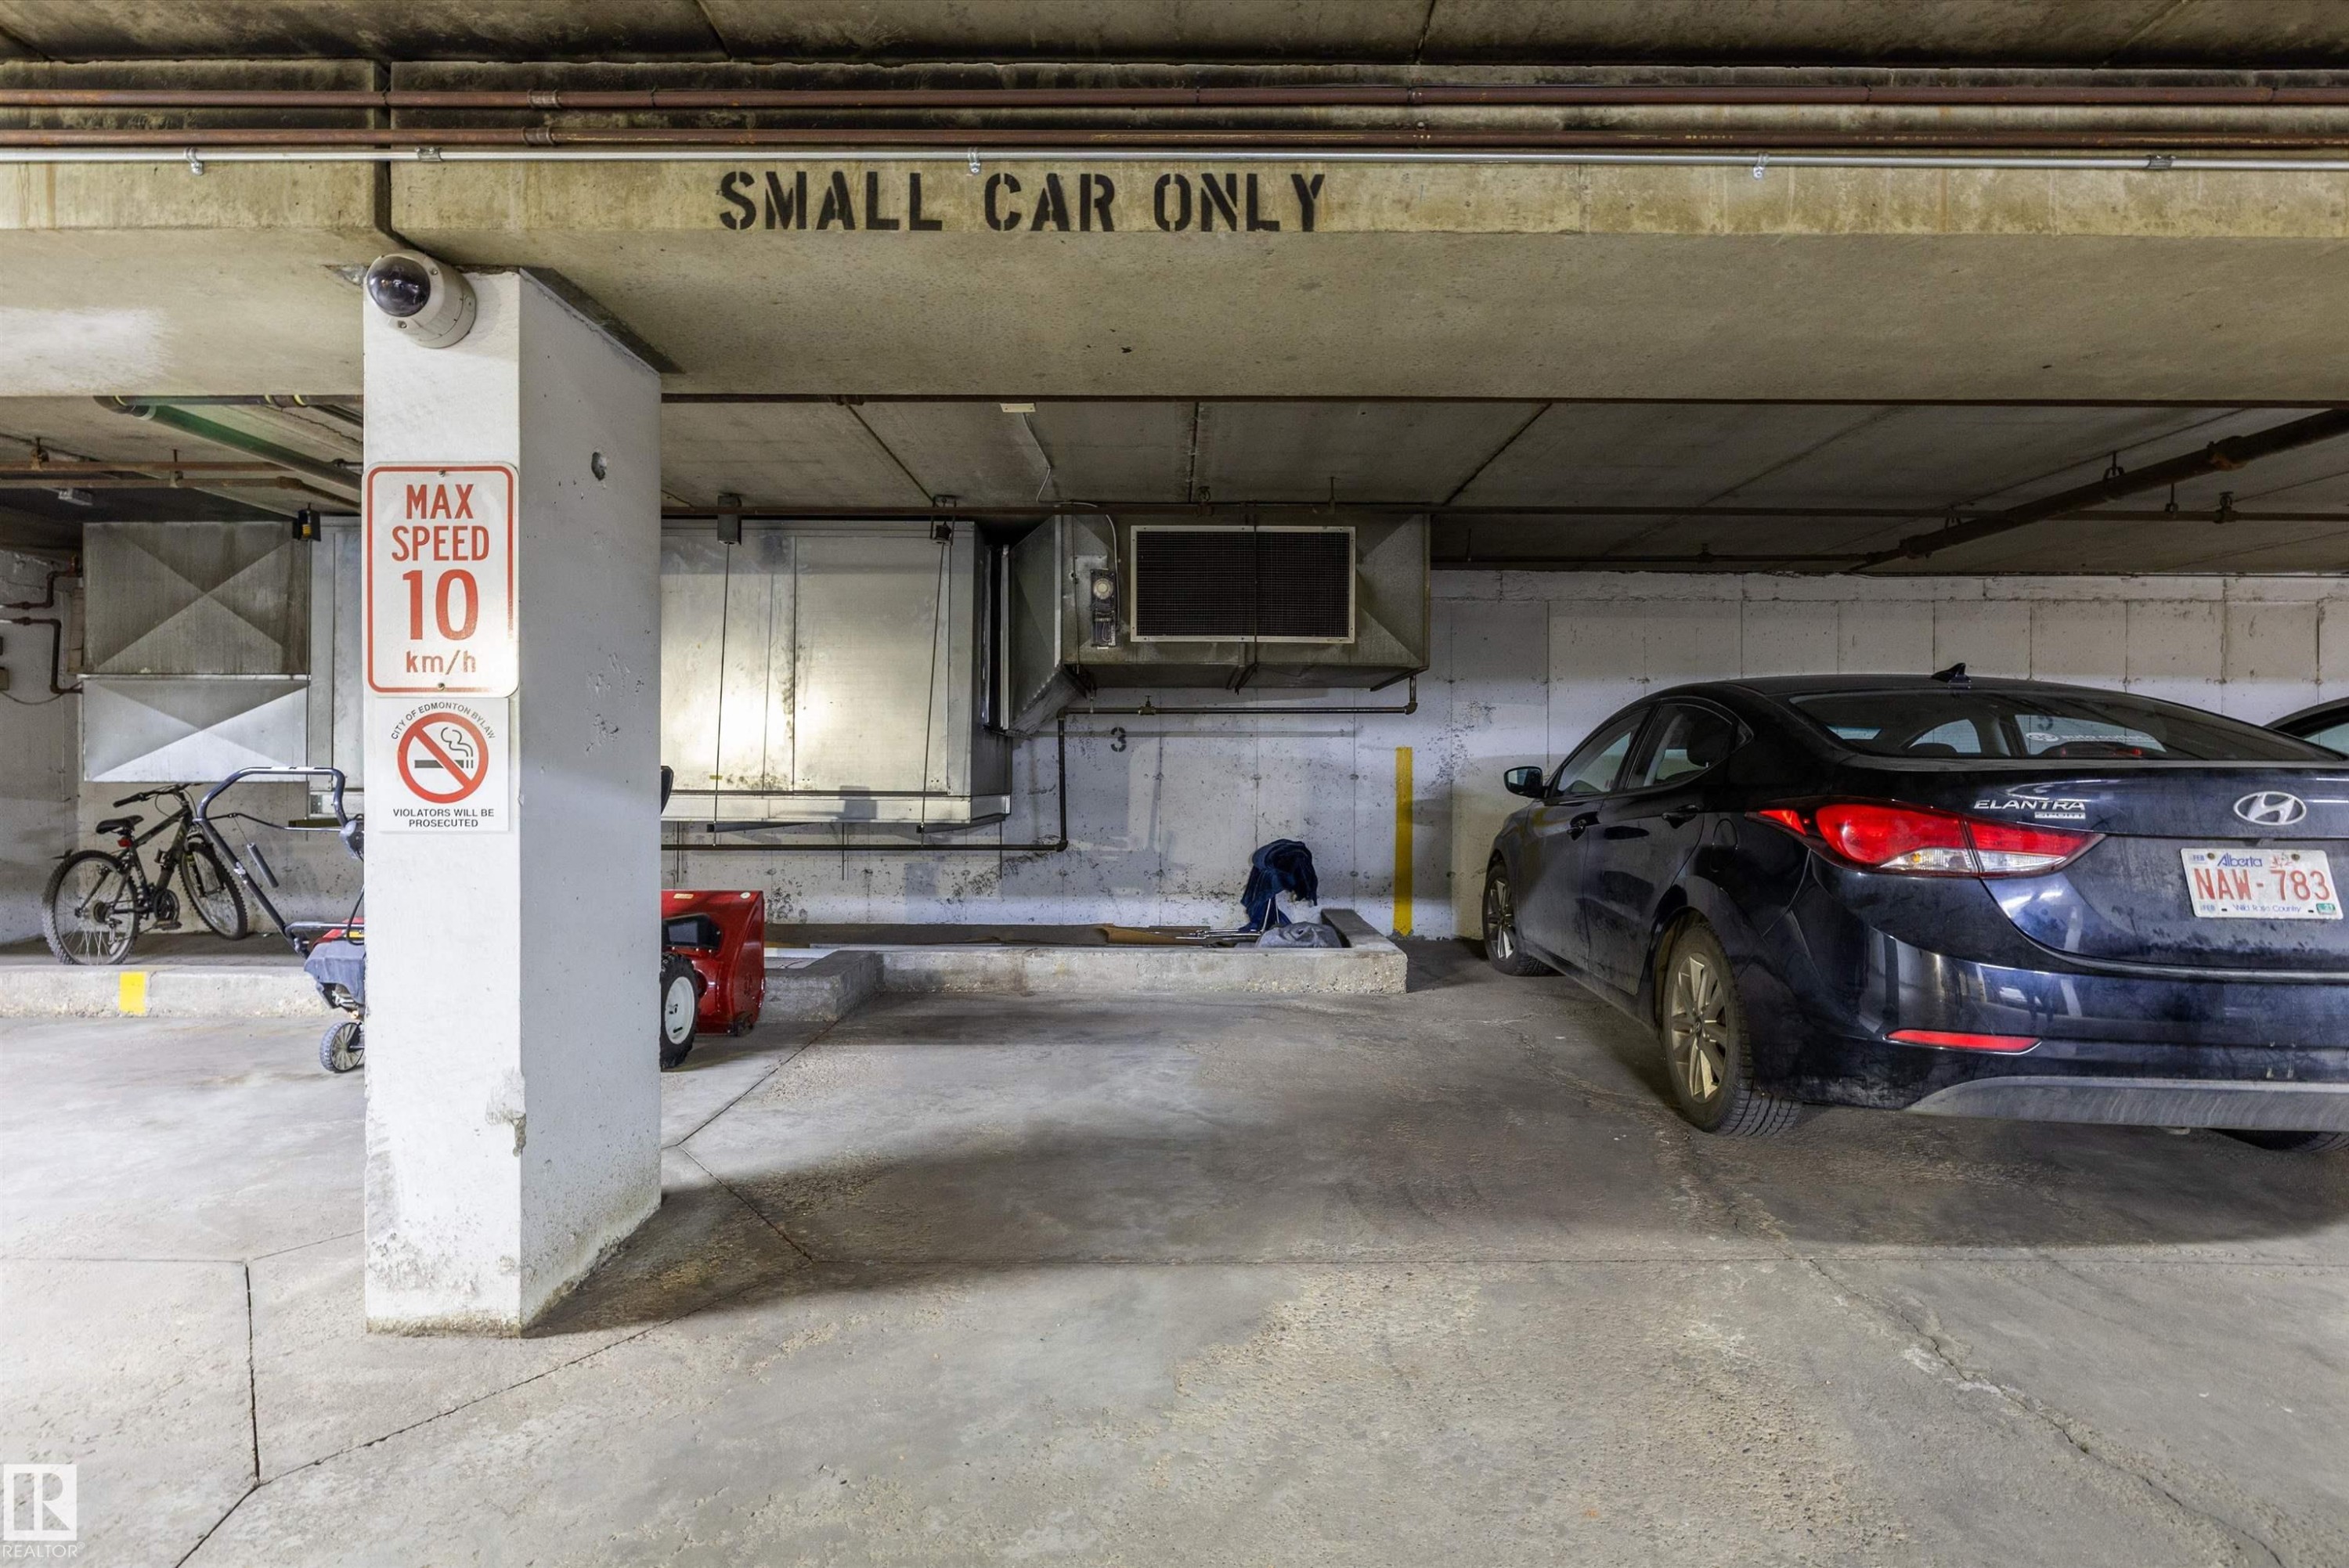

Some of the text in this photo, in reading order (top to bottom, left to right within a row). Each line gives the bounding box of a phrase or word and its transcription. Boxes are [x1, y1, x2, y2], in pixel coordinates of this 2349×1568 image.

[719, 171, 1326, 232] SMALL CAR ONLY
[406, 484, 474, 519] MAX
[392, 525, 489, 561] SPEED
[402, 568, 478, 640] 10
[406, 650, 476, 675] km/h
[391, 701, 496, 740] CITY OF EDMONTON BYLAW
[1110, 727, 1127, 752] 3
[393, 809, 494, 817] VIOLATORS WILL BE
[1973, 799, 2086, 811] ELANTRA
[409, 819, 478, 827] PROSECUTED
[2217, 852, 2263, 867] Alberta
